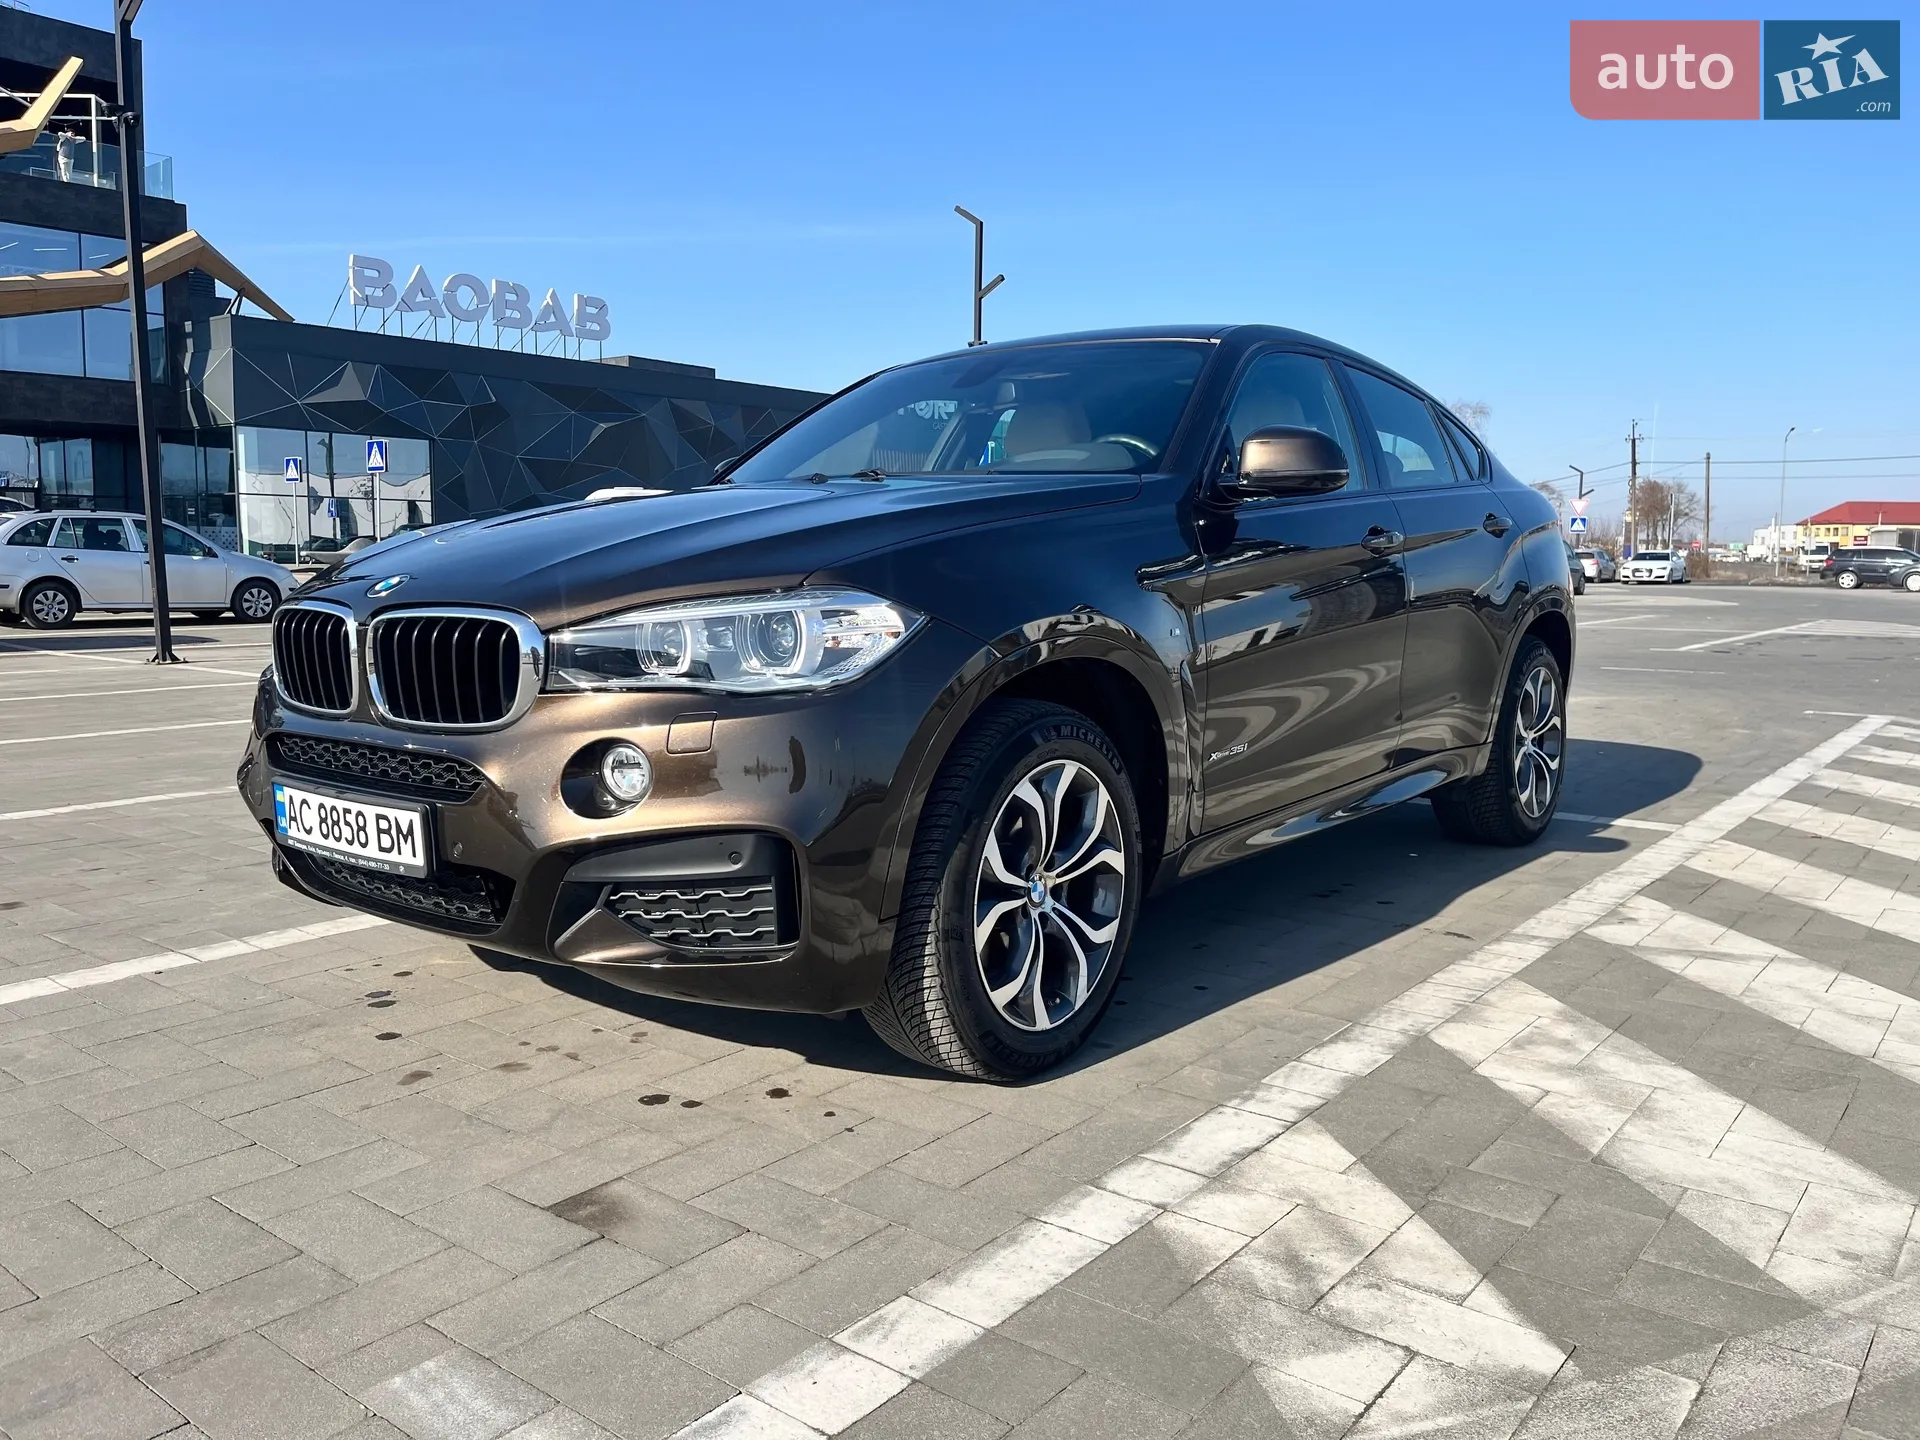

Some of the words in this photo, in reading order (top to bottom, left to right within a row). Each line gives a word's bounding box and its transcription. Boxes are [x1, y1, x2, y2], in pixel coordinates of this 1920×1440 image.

[348, 253, 612, 342] BAOBAB
[1060, 725, 1121, 770] MICHELIN
[288, 794, 313, 836] AC
[318, 802, 369, 849] 8858
[375, 813, 417, 858] BM
